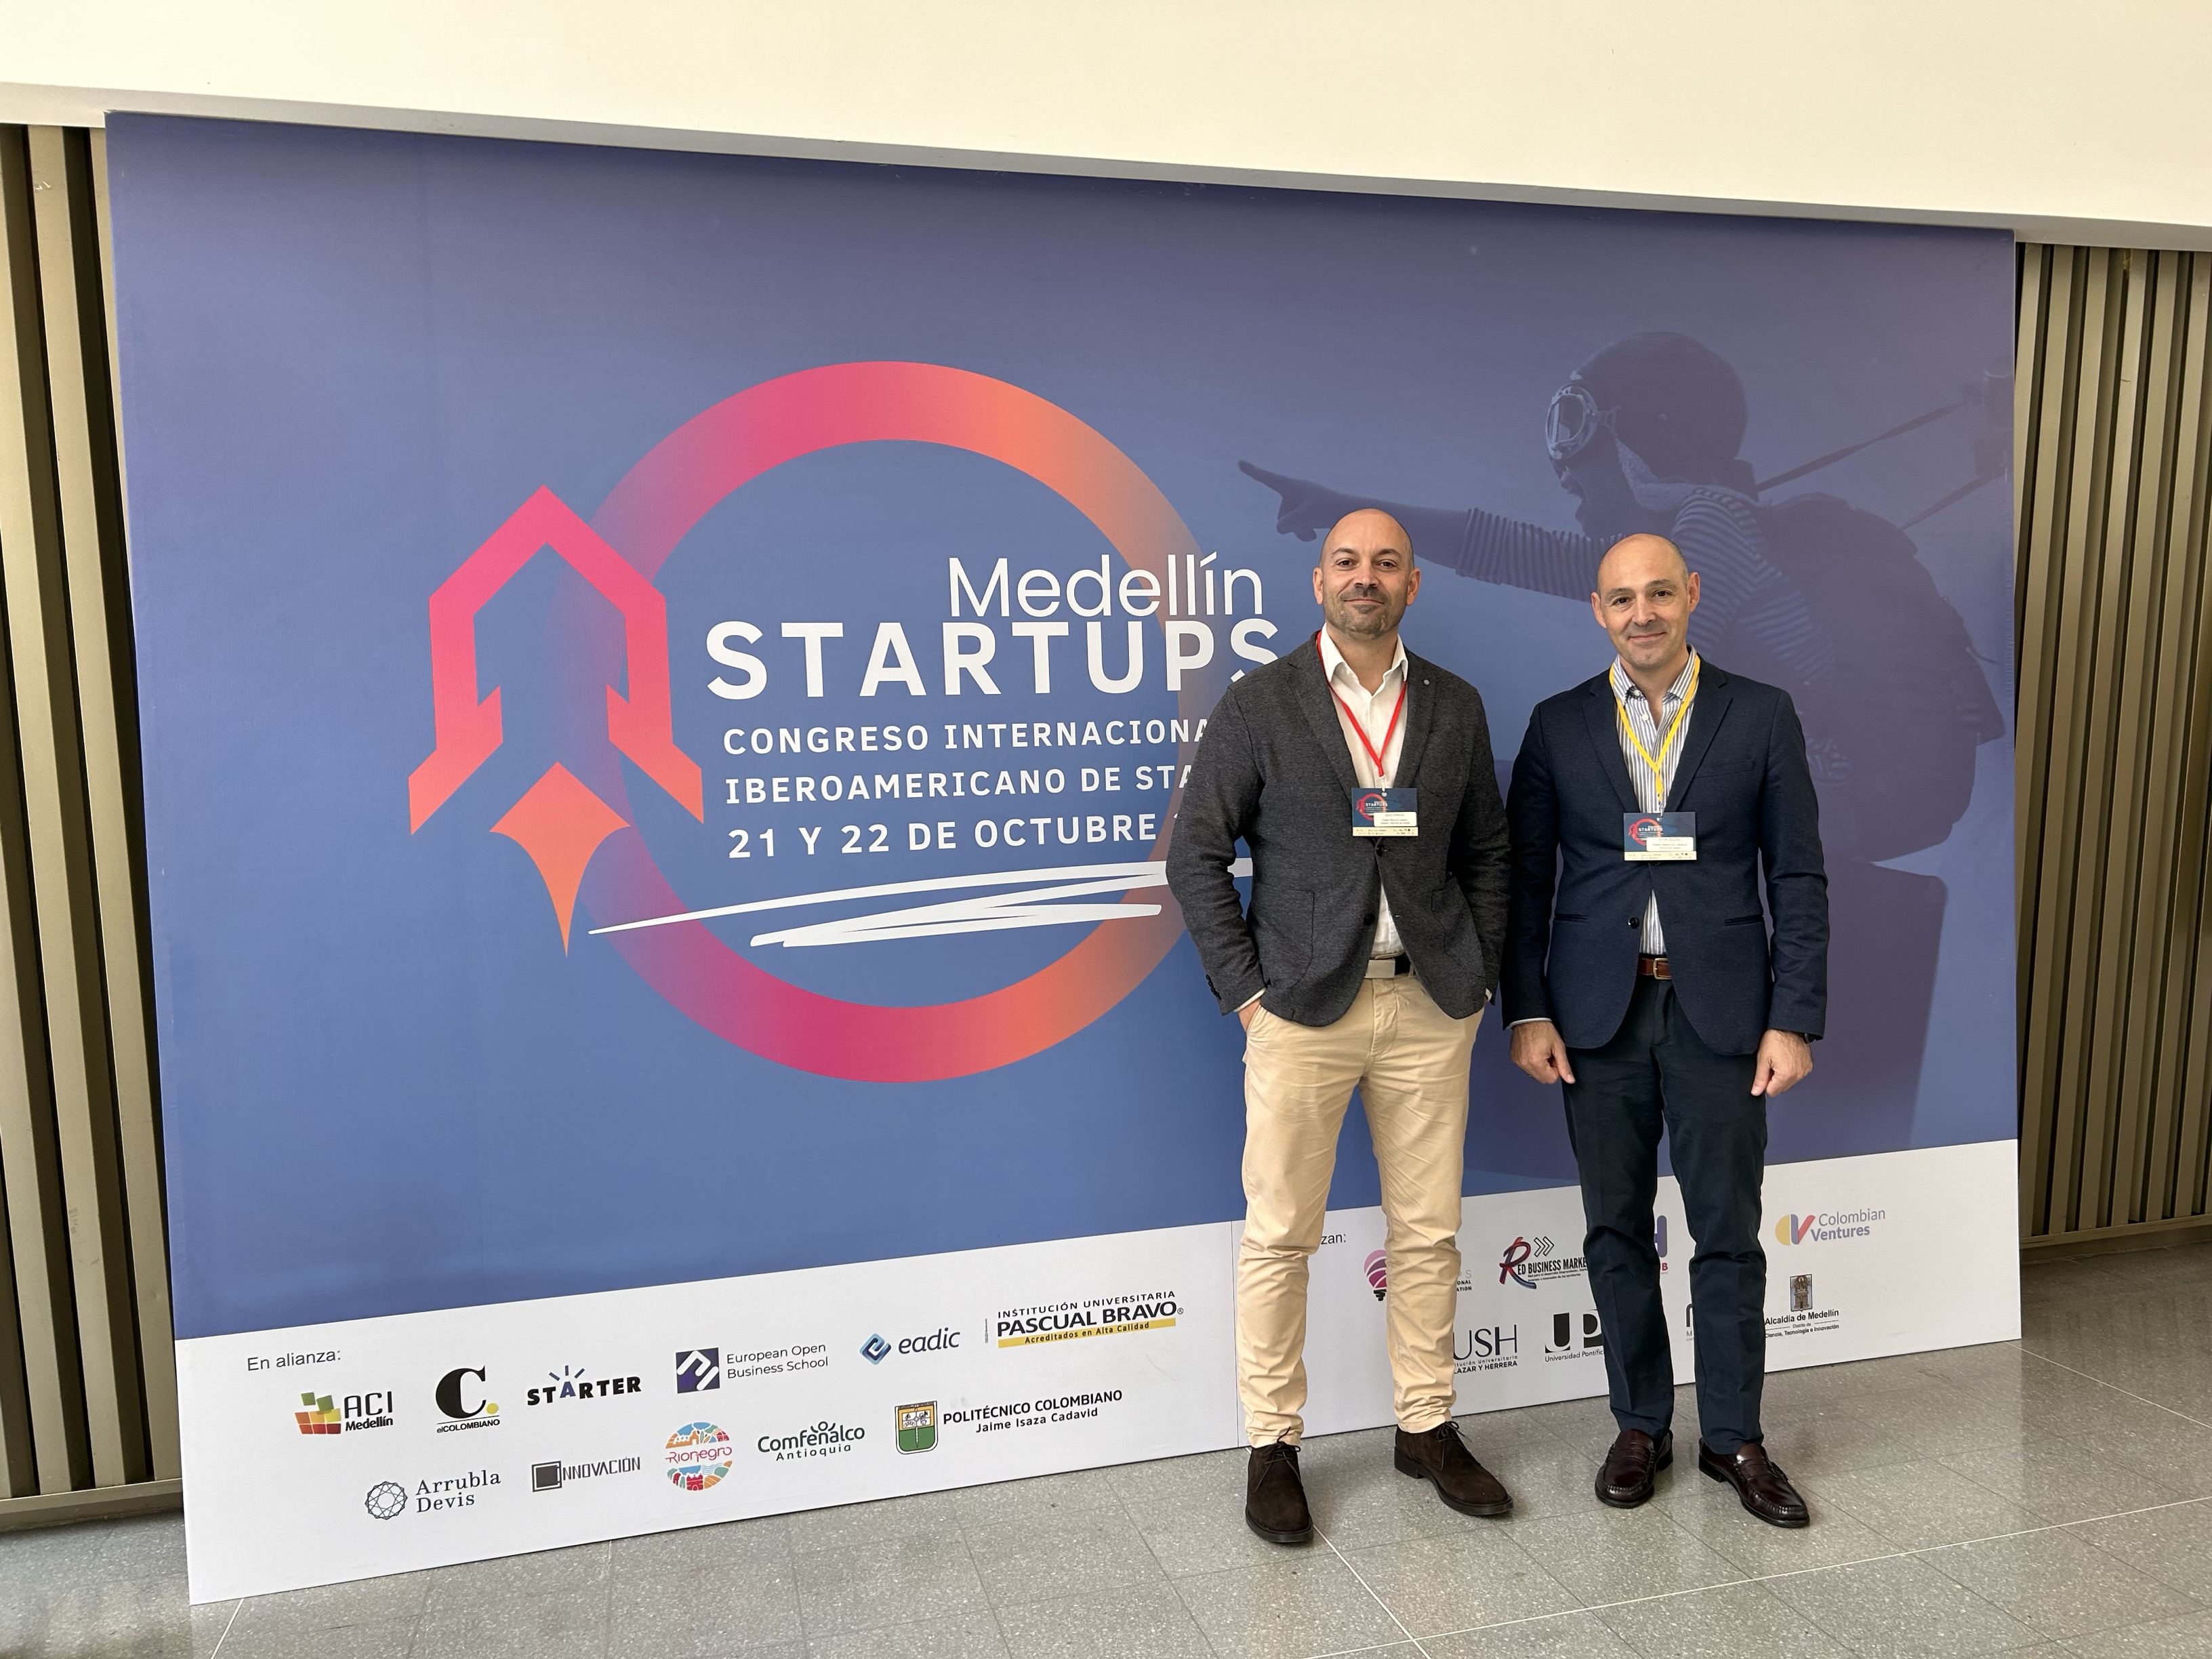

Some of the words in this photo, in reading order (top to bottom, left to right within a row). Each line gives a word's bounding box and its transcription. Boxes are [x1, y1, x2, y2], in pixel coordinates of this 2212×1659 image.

[949, 551, 1263, 617] Medellín
[706, 618, 1279, 700] STARTUPS
[723, 724, 929, 754] CONGRESO
[726, 769, 1066, 804] IBEROAMERICANO
[1082, 766, 1121, 792] DE
[729, 829, 775, 859] 21
[799, 827, 822, 855] Y
[841, 824, 890, 853] 22
[909, 821, 956, 851] DE
[975, 813, 1156, 848] OCTUBRE
[1819, 1208, 1885, 1227] Colombian
[1810, 1226, 1870, 1242] Ventures
[1528, 1259, 1561, 1274] BUSINESS
[998, 1301, 1078, 1318] INSTITUCIÓN
[1084, 1290, 1175, 1307] UNIVERSITARIA
[998, 1311, 1097, 1336] PASCUAL
[1764, 1315, 1795, 1325] Alcaldía
[1808, 1309, 1839, 1319] Medellín
[898, 1327, 961, 1354] eadic
[1025, 1331, 1078, 1344] Acreditados
[1096, 1326, 1113, 1335] Alta
[1117, 1322, 1149, 1332] Calidad
[247, 1357, 270, 1371] En
[276, 1350, 341, 1368] alianza:
[726, 1348, 788, 1364] European
[792, 1343, 827, 1359] Open
[1484, 1360, 1517, 1370] HERRERA
[1545, 1352, 1580, 1362] Universidad
[727, 1366, 784, 1379] Business
[787, 1355, 829, 1372] School
[527, 1376, 642, 1406] STARTER
[344, 1391, 393, 1418] ACI
[943, 1402, 1031, 1425] POLITÉCNICO
[1035, 1390, 1122, 1411] COLOMBIANO
[345, 1415, 393, 1431] Medellín
[976, 1420, 1011, 1433] Jaime
[1016, 1416, 1046, 1428] Isaza
[1051, 1408, 1098, 1422] Cadavid
[758, 1422, 865, 1453] Comfenalco
[665, 1446, 732, 1464] Rionegro
[776, 1443, 851, 1461] Antioquia
[415, 1469, 501, 1496] Arrubla
[416, 1491, 475, 1513] Devis
